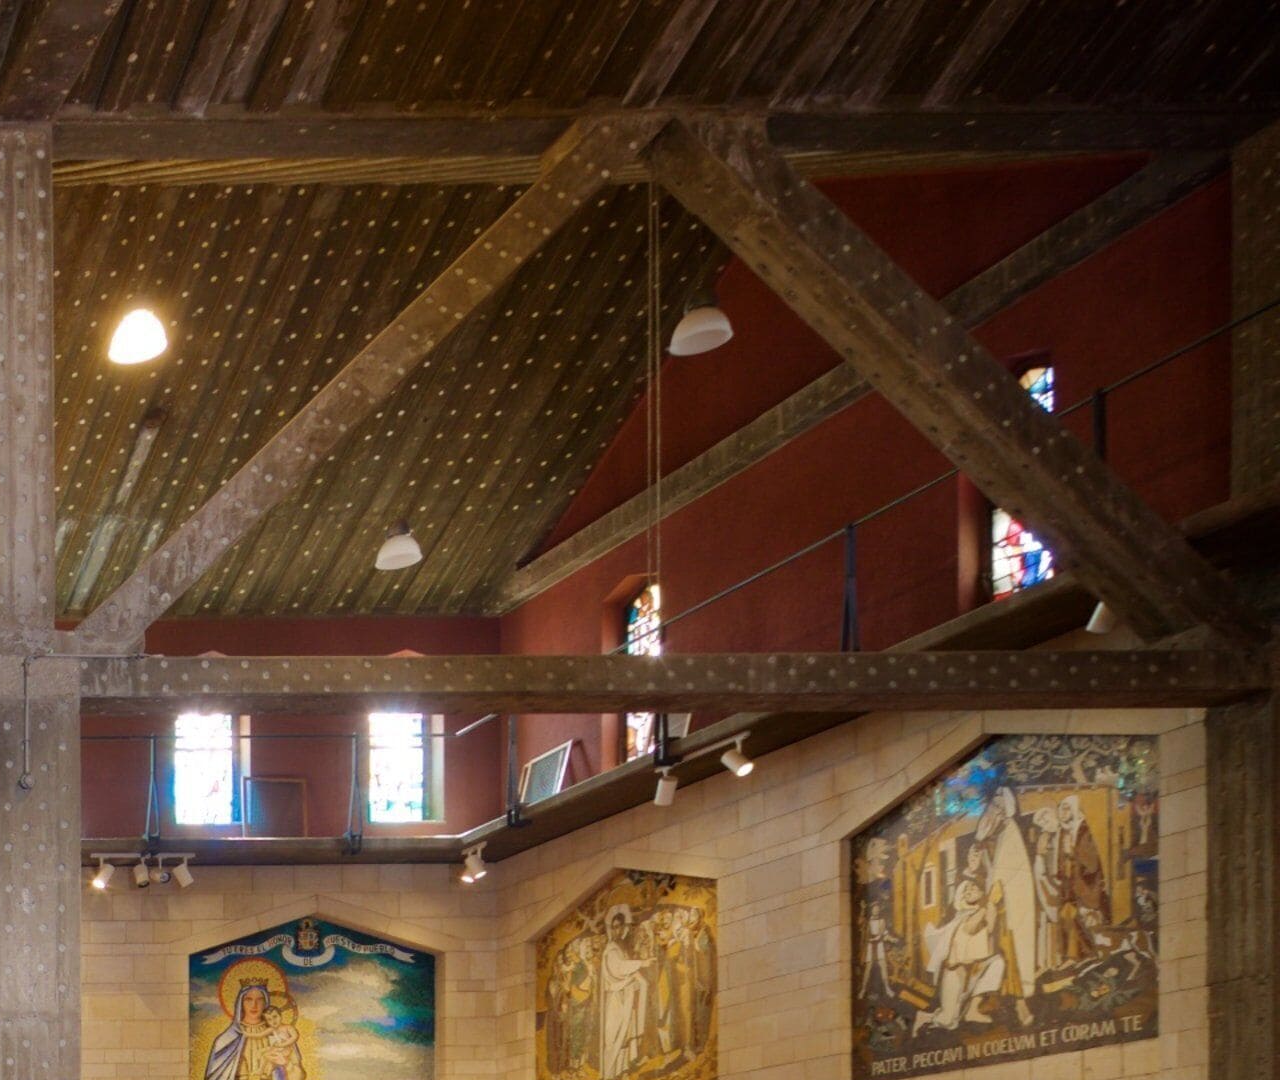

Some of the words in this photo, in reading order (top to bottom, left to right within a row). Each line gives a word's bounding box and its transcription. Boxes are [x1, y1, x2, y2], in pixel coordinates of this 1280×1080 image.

[303, 957, 313, 966] DE
[912, 1045, 963, 1069] PECCAVI
[966, 1043, 982, 1061] IN
[1039, 1029, 1059, 1048] ET
[1061, 1019, 1117, 1043] CORAM
[1120, 1014, 1144, 1034] TE
